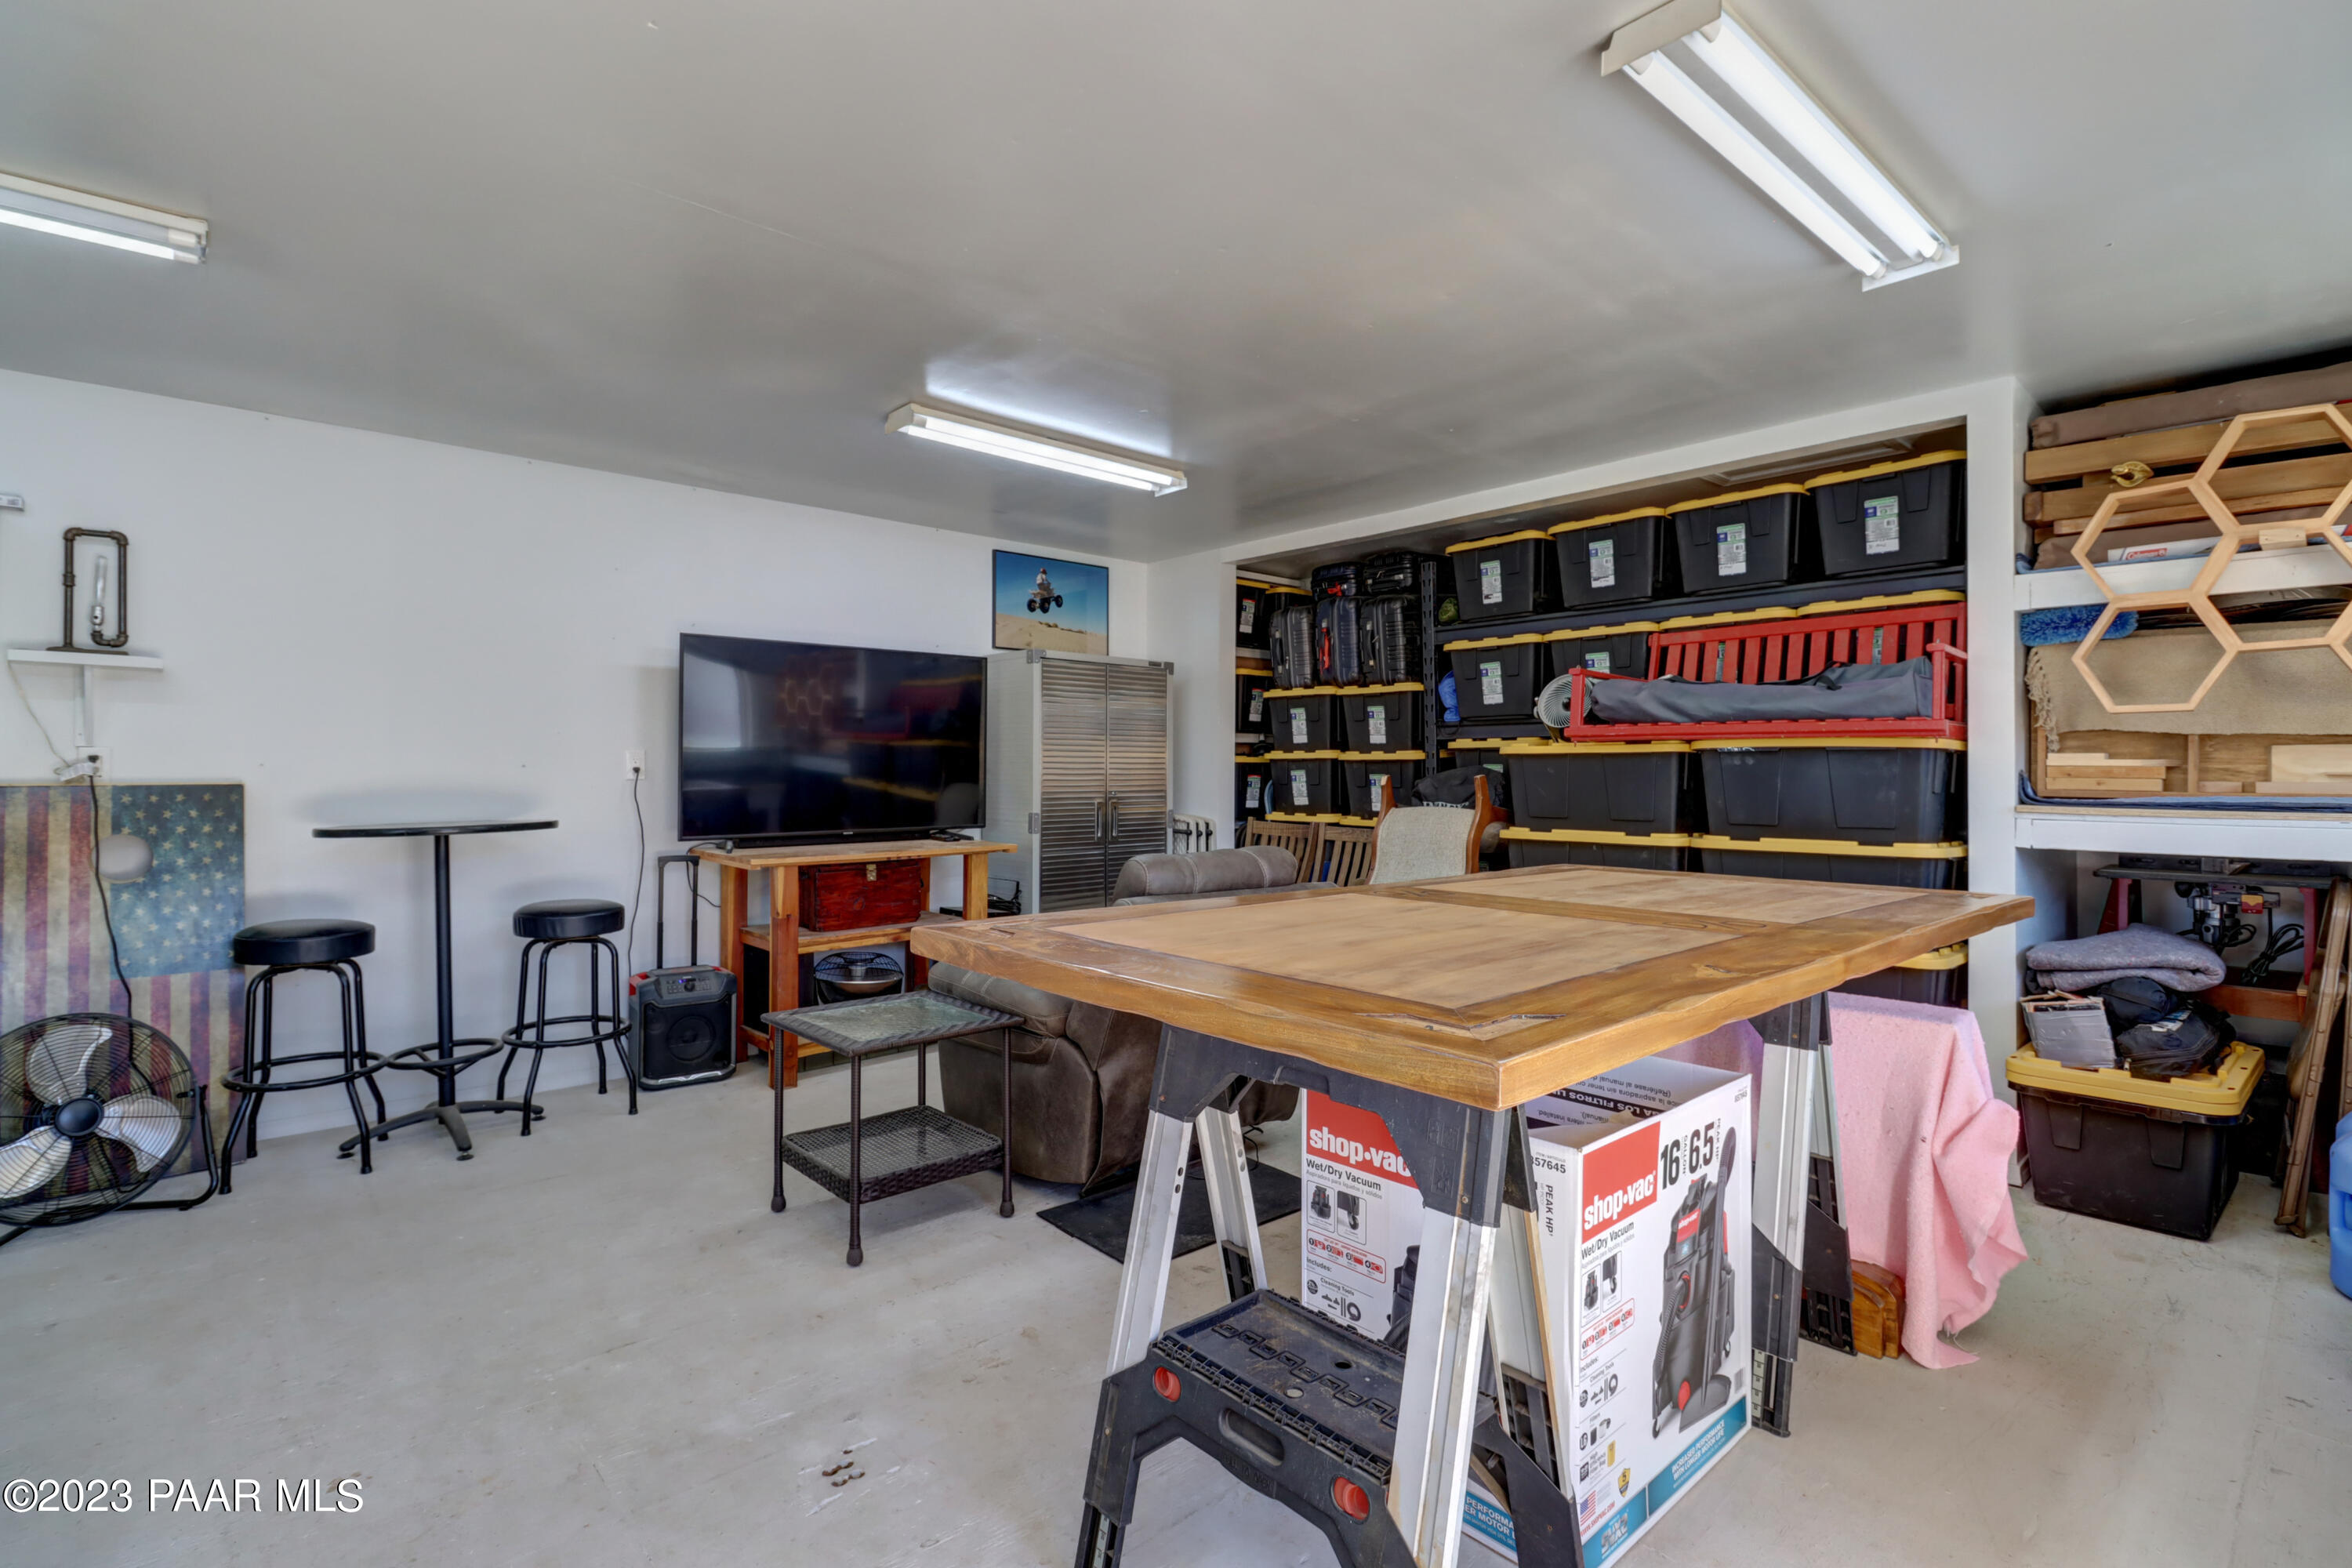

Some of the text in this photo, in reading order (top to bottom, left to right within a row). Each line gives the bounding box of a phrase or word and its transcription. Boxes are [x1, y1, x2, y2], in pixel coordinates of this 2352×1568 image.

[1599, 1076, 1624, 1087] manual
[1569, 1091, 1614, 1108] FILTROS
[1617, 1102, 1639, 1116] LOS
[1306, 1158, 1381, 1192] Wet/Dry Vacuum
[1661, 1138, 1681, 1190] 16
[1545, 1184, 1554, 1215] PEAK
[1581, 1236, 1608, 1261] Wet/Dry
[1610, 1221, 1634, 1242] Vacuum
[1320, 1277, 1341, 1290] Cleaning
[1341, 1287, 1355, 1296] Tools
[1478, 1511, 1510, 1537] MOTOR
